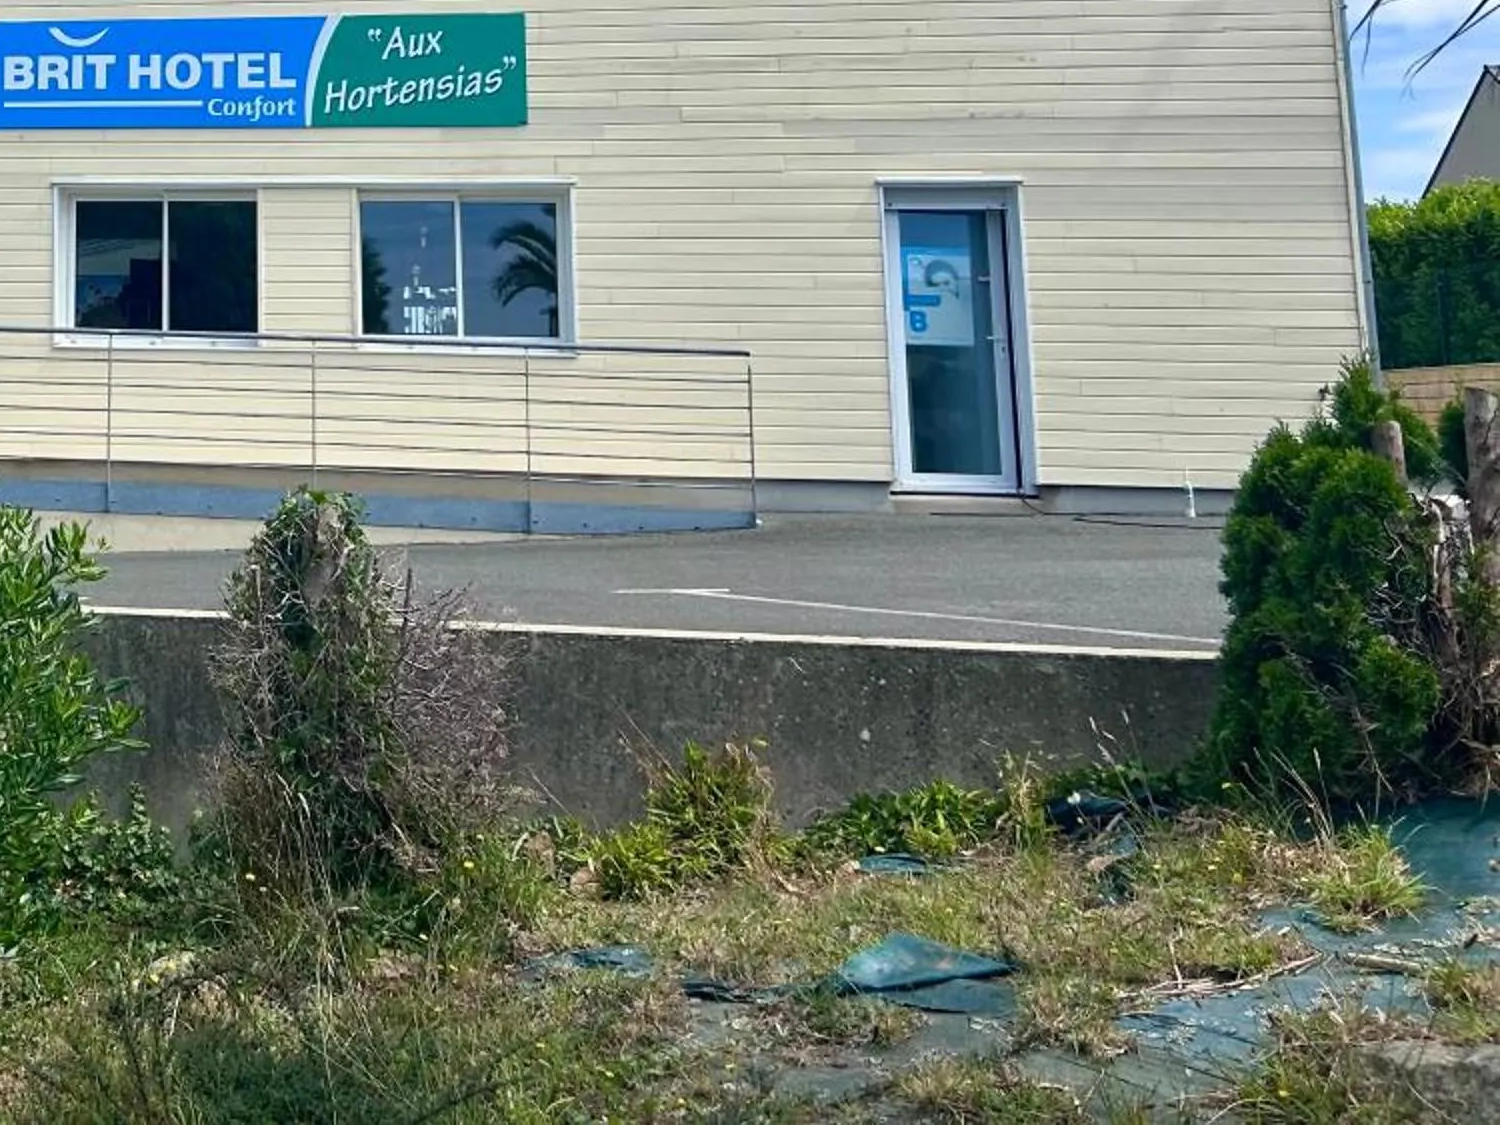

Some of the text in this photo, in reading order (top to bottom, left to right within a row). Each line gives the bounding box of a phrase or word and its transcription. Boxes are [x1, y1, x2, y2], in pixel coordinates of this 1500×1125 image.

[3, 52, 297, 90] BRIT HOTEL
[207, 95, 296, 122] Confort
